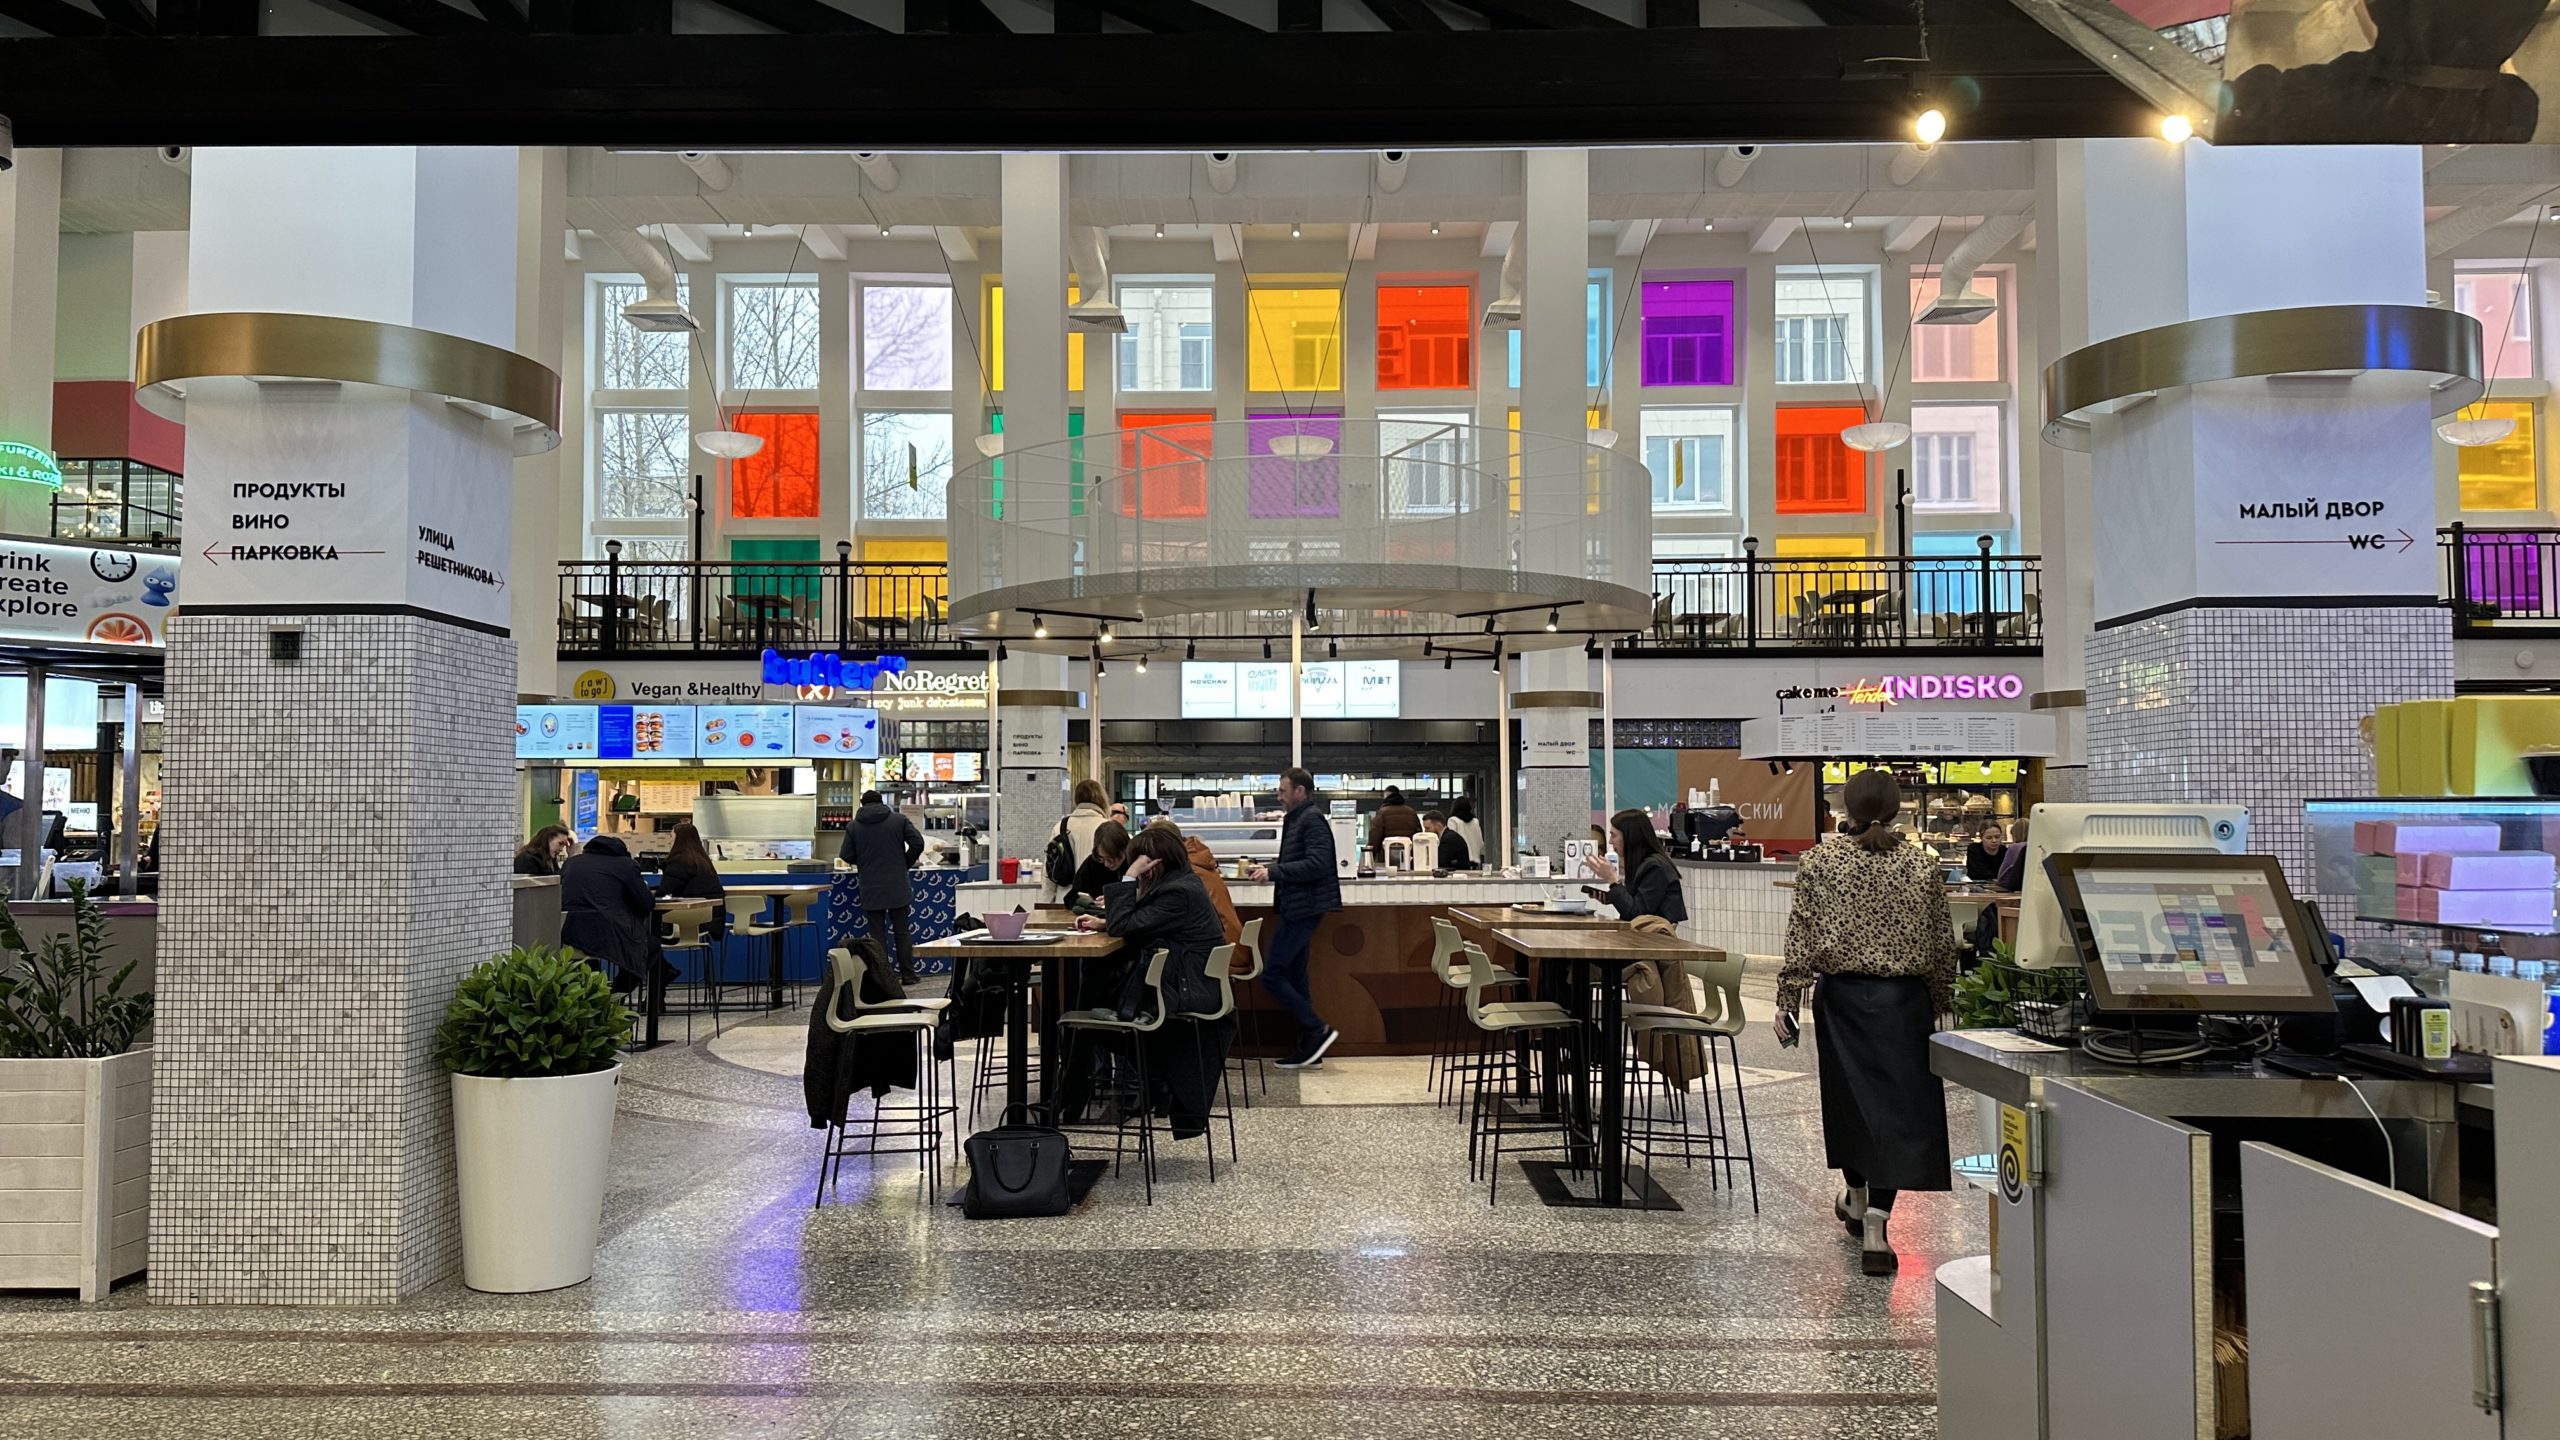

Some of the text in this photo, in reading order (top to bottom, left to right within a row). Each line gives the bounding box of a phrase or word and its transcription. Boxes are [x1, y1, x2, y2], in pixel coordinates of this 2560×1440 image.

[233, 483, 345, 500] ПРОДУКТЫ
[2240, 498, 2384, 520] МАЛЫЙ ДВОР
[232, 514, 290, 530] ВИНО
[418, 525, 455, 551] УЛИЦА
[2348, 534, 2386, 550] WC
[231, 545, 339, 560] ПАРКОВКА
[418, 550, 495, 586] РЕШЕТНИКОВА
[631, 682, 682, 699] Vegan
[1880, 674, 2023, 699] INDISKO
